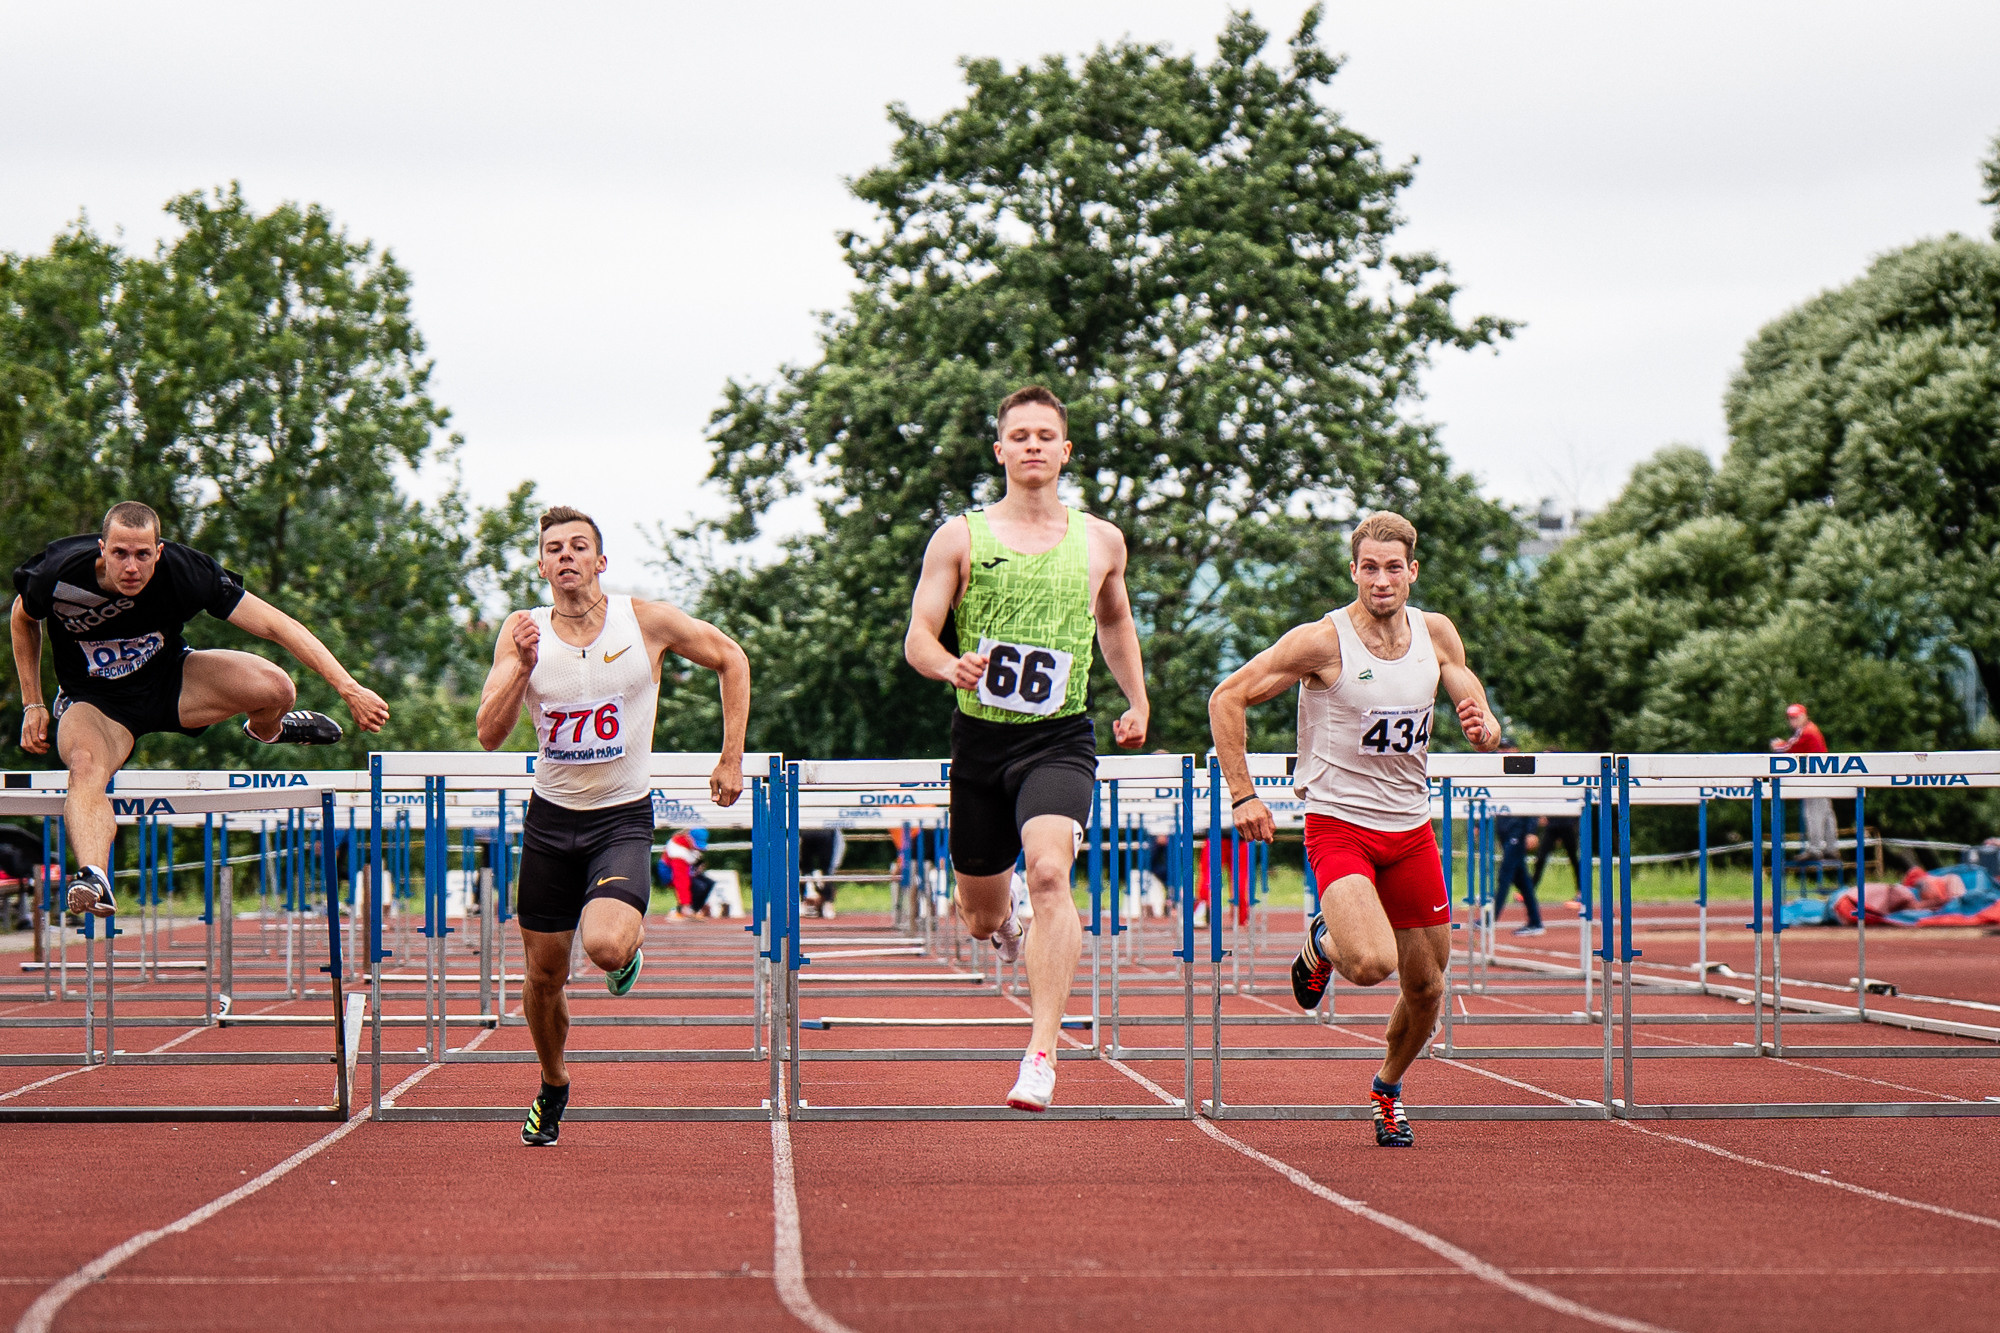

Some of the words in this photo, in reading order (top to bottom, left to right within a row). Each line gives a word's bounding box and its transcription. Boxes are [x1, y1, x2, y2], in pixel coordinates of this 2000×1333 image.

[64, 598, 135, 633] didas
[986, 645, 1056, 704] 66
[545, 703, 620, 743] 776
[1361, 711, 1429, 753] 434
[1769, 756, 1869, 774] DIMA
[228, 774, 308, 788] DIMA
[1891, 776, 1970, 785] DIMA
[860, 795, 915, 804] DIMA
[1429, 786, 1490, 797] DMA
[112, 798, 176, 815] MA
